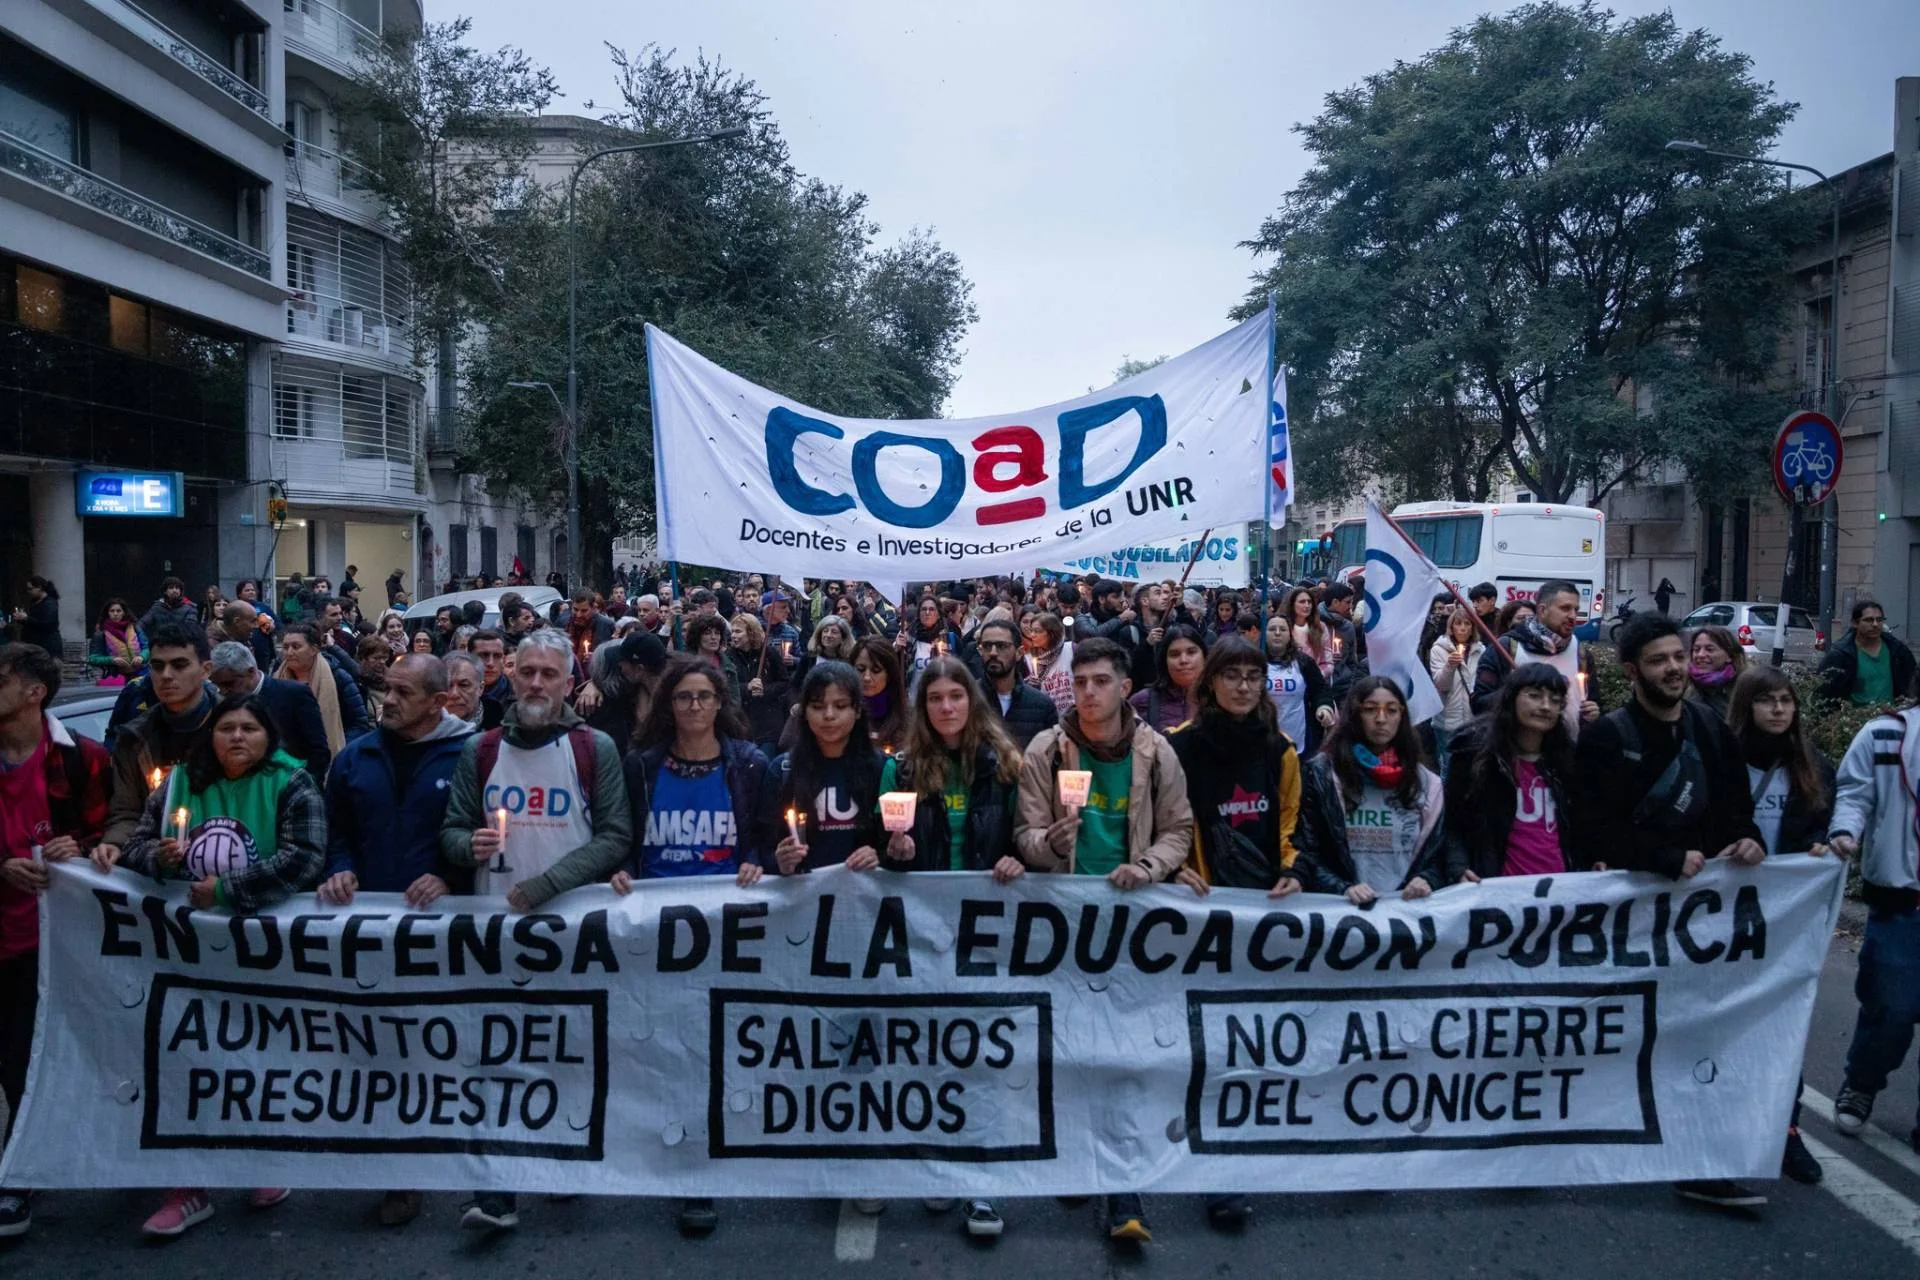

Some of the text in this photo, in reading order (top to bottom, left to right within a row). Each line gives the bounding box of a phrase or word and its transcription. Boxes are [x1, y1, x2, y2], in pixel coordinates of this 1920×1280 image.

[143, 480, 161, 508] E
[740, 476, 1196, 559] Docentes e Investigadores de la UNR
[1063, 556, 1139, 578] UCHA
[1112, 537, 1238, 563] JUBILADOS
[92, 889, 200, 963] EN
[229, 909, 620, 978] DEFENSA
[656, 902, 768, 973] DE
[810, 895, 912, 978] LA
[1451, 878, 1767, 969] PÚBLICA
[167, 999, 584, 1066] AUMENTO DEL
[737, 1015, 1017, 1069] SALARIOS
[1226, 1005, 1625, 1067] NO AL CIERRE
[187, 1068, 558, 1130] PRESUPUESTO
[763, 1081, 966, 1134] DIGNOS
[1217, 1068, 1584, 1127] DEL CONICET
